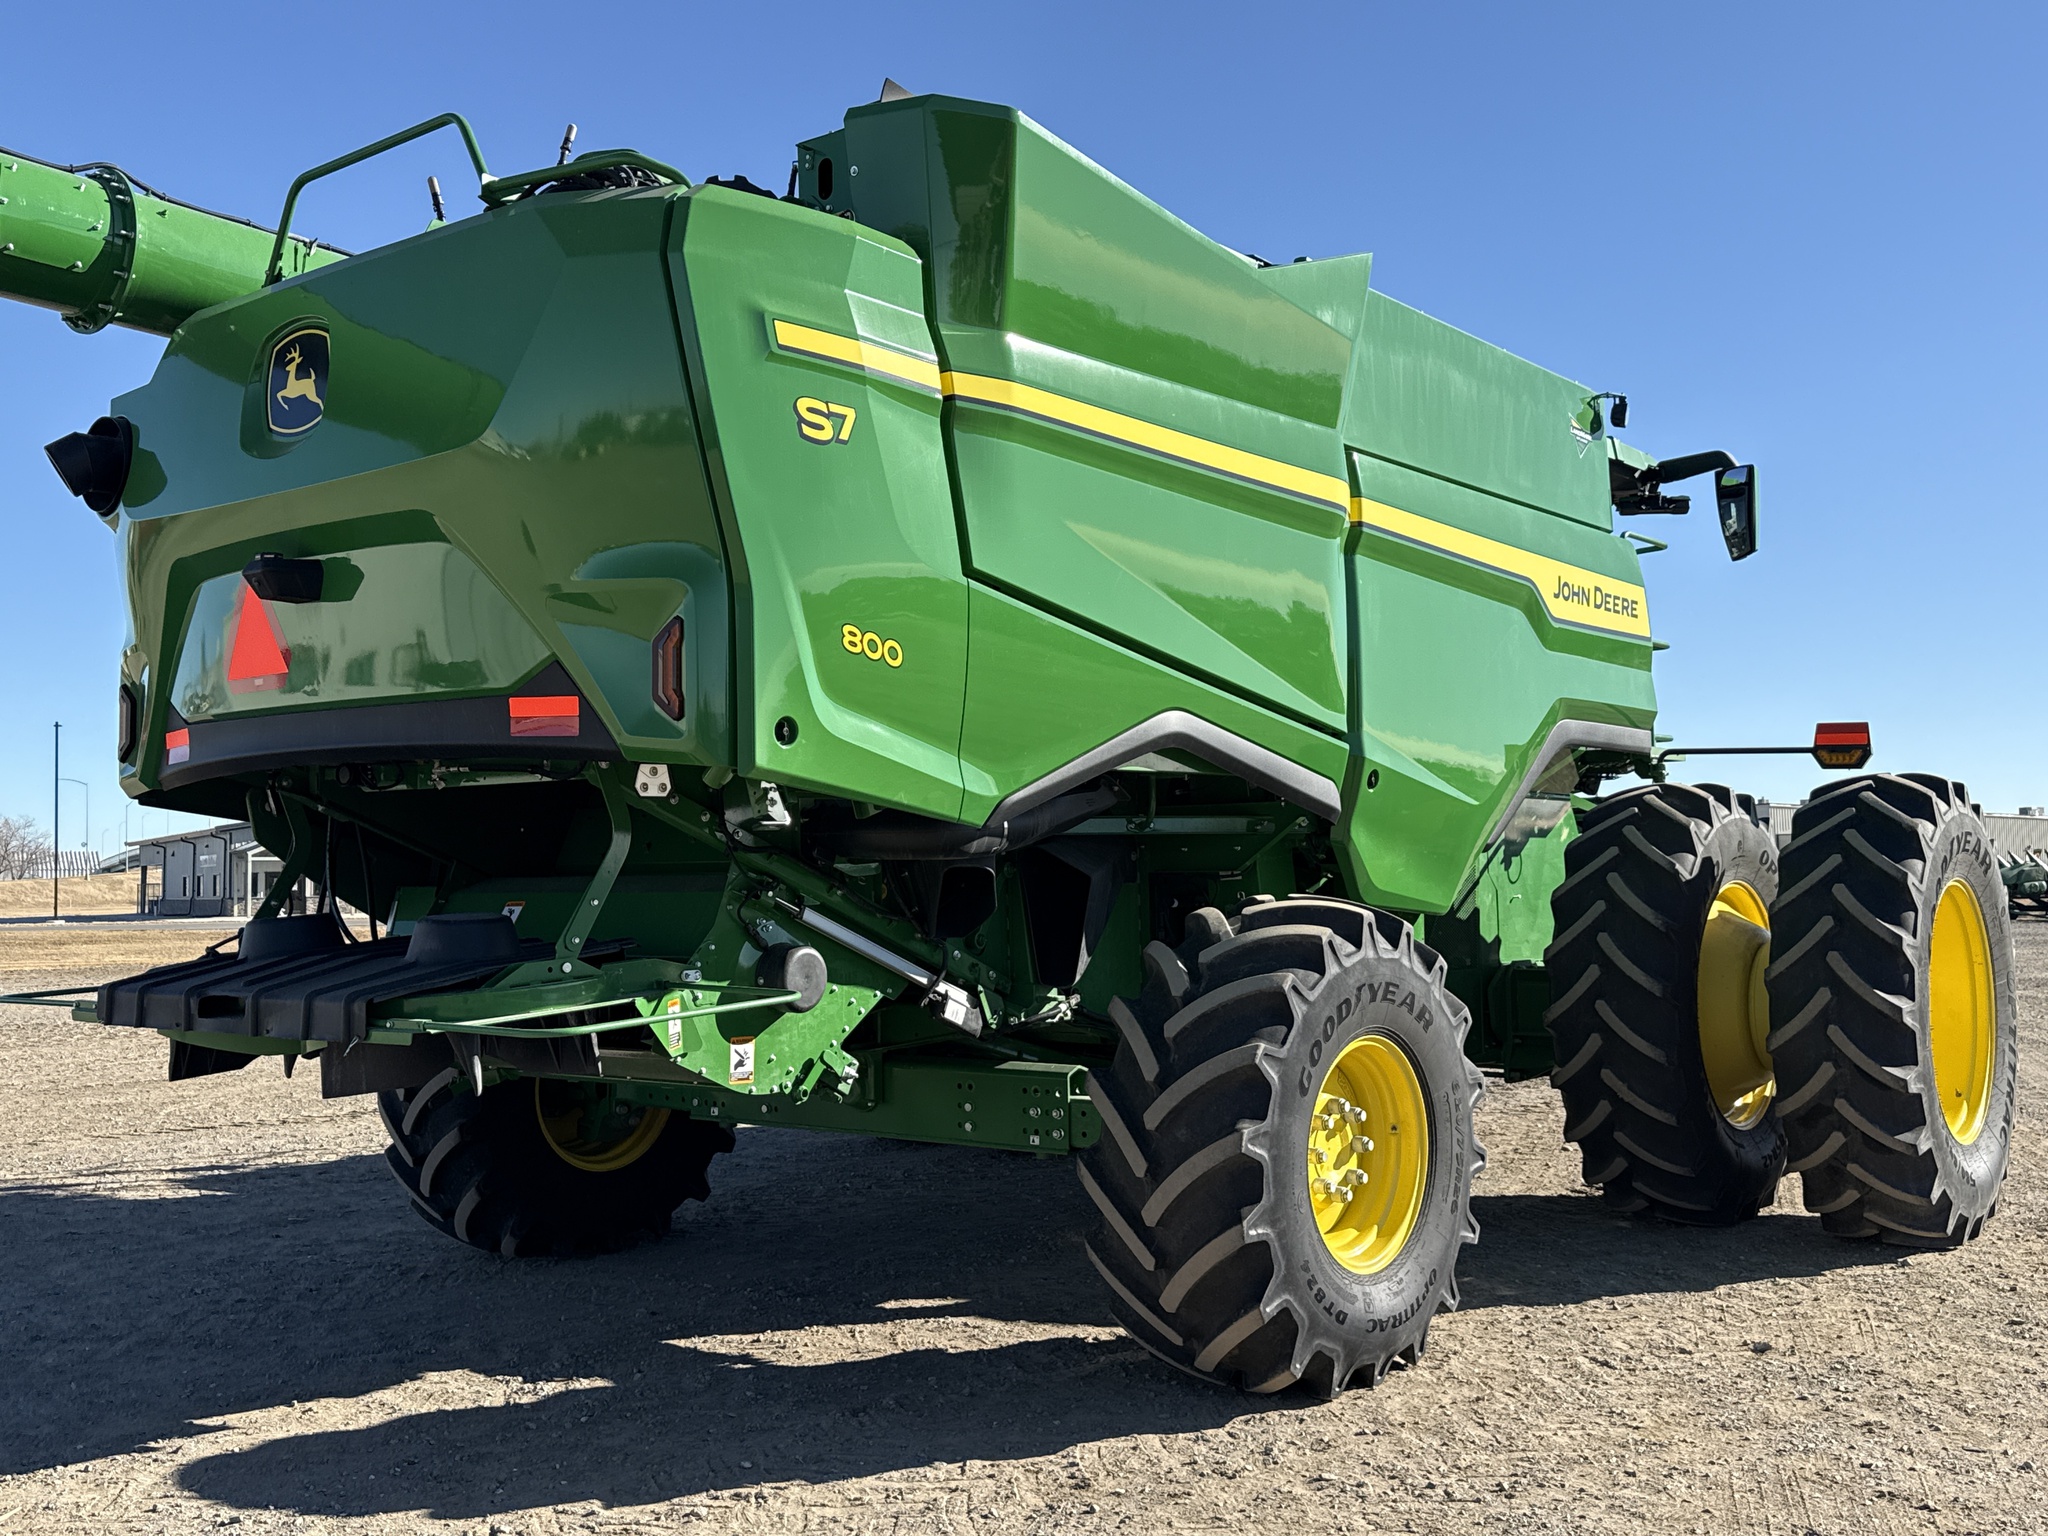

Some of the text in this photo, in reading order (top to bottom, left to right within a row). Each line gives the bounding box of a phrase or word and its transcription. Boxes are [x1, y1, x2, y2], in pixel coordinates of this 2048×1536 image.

[793, 396, 857, 445] S7
[841, 623, 904, 668] 800
[1298, 981, 1434, 1098] GOODYEAR
[2000, 970, 2017, 1149] OPTITRAC
[1300, 1259, 1349, 1326] DT824
[1366, 1268, 1437, 1334] OPTITRAC
